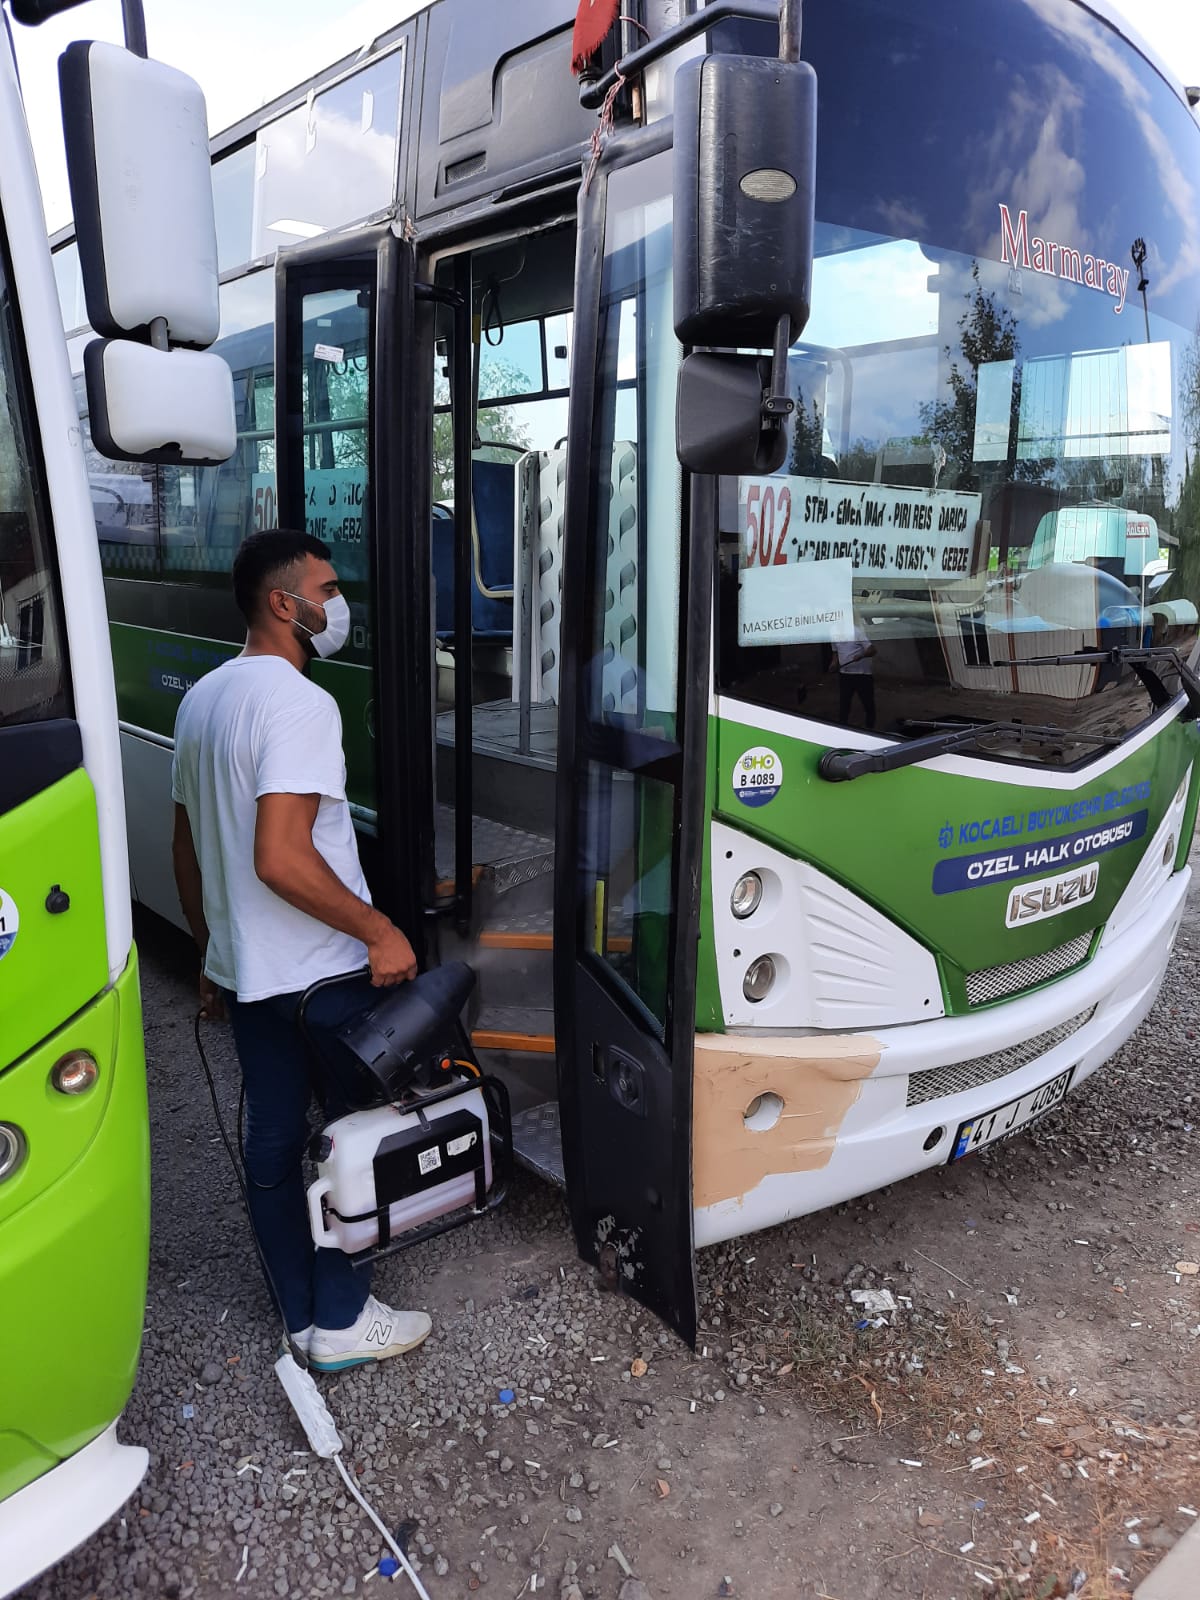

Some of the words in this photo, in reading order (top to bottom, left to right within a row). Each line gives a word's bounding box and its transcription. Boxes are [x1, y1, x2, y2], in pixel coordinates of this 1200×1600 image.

[999, 203, 1129, 314] Marmaray
[255, 485, 278, 531] 50
[746, 484, 792, 567] 502
[912, 503, 933, 531] REIS
[941, 546, 970, 571] GEBZE
[741, 774, 747, 786] B
[750, 773, 775, 785] 4089
[1024, 841, 1070, 869] HALK
[1073, 820, 1134, 856] OTOBÜSÜ
[1008, 867, 1097, 923] ISUZU
[972, 1113, 997, 1145] 41
[1005, 1101, 1021, 1130] J
[1030, 1074, 1067, 1114] 4089
